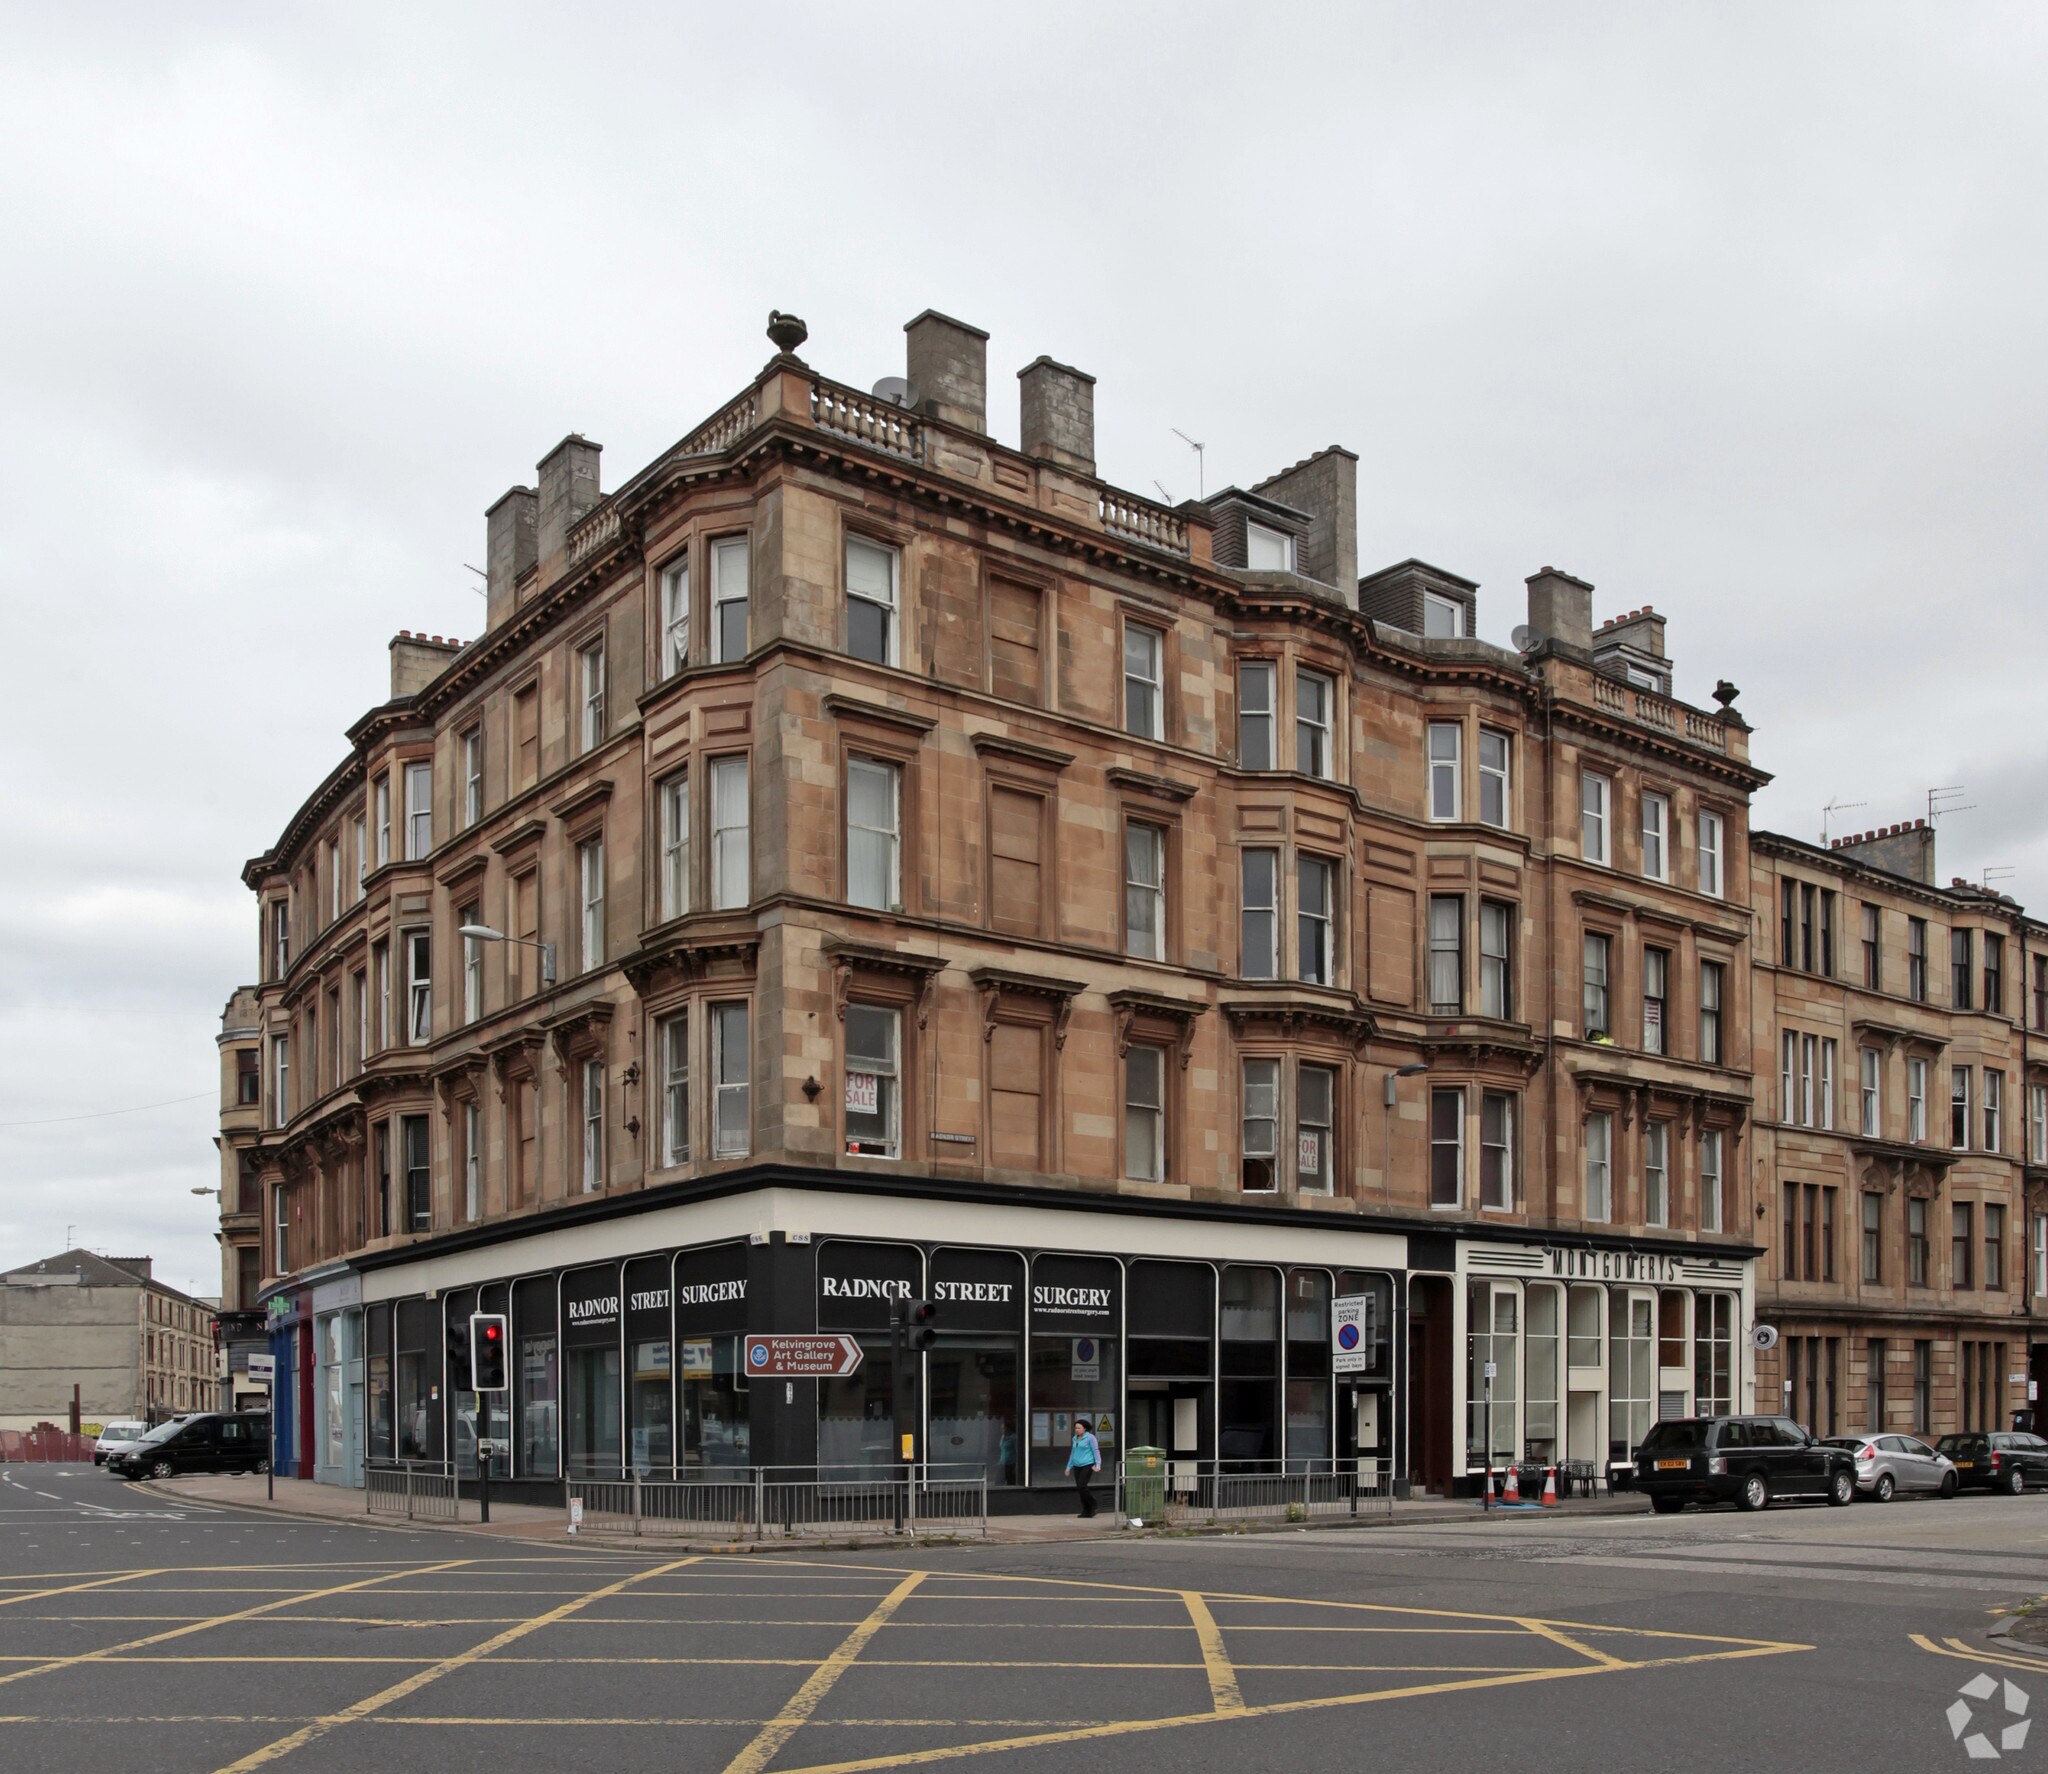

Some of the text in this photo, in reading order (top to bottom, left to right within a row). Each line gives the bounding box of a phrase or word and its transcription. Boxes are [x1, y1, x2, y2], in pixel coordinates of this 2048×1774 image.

[846, 1071, 875, 1091] FOR
[845, 1089, 875, 1107] SALE
[1299, 1138, 1317, 1155] OR
[1299, 1154, 1317, 1169] ALE
[1553, 1248, 1675, 1282] MONTGOMERYS
[568, 1279, 748, 1319] RADNOR STREET SURGERY
[822, 1277, 1111, 1306] RADNOR STREET SURGERY
[1033, 1306, 1110, 1316] www.radnorstreetsurgery.com
[1338, 1314, 1358, 1322] ZONE
[771, 1339, 836, 1351] Kelvingrove
[773, 1350, 835, 1361] Art Gallery
[775, 1361, 833, 1371] & Museum
